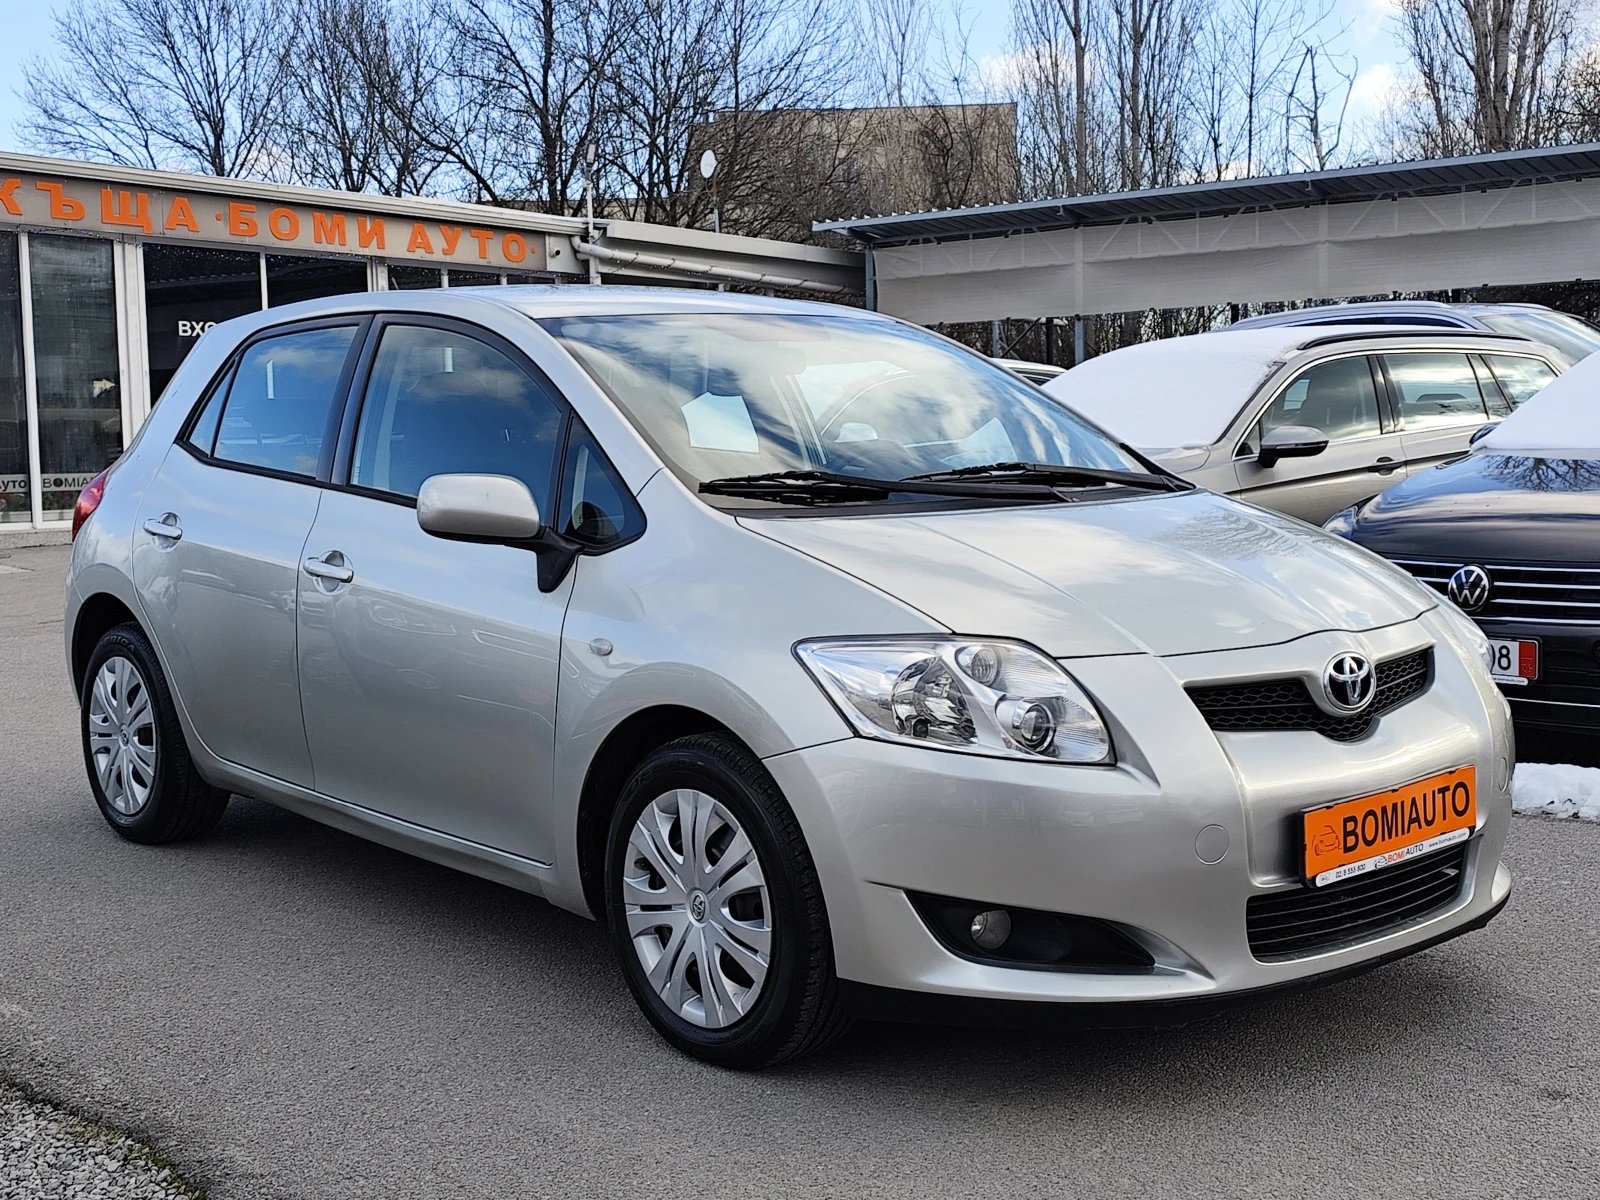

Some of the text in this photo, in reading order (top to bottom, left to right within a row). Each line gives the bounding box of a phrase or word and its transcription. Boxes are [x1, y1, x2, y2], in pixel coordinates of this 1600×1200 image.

[228, 202, 386, 250] БОМИ
[407, 222, 527, 263] АУТО
[43, 477, 93, 489] BOMIA
[1342, 781, 1470, 854] BOMIAUTO
